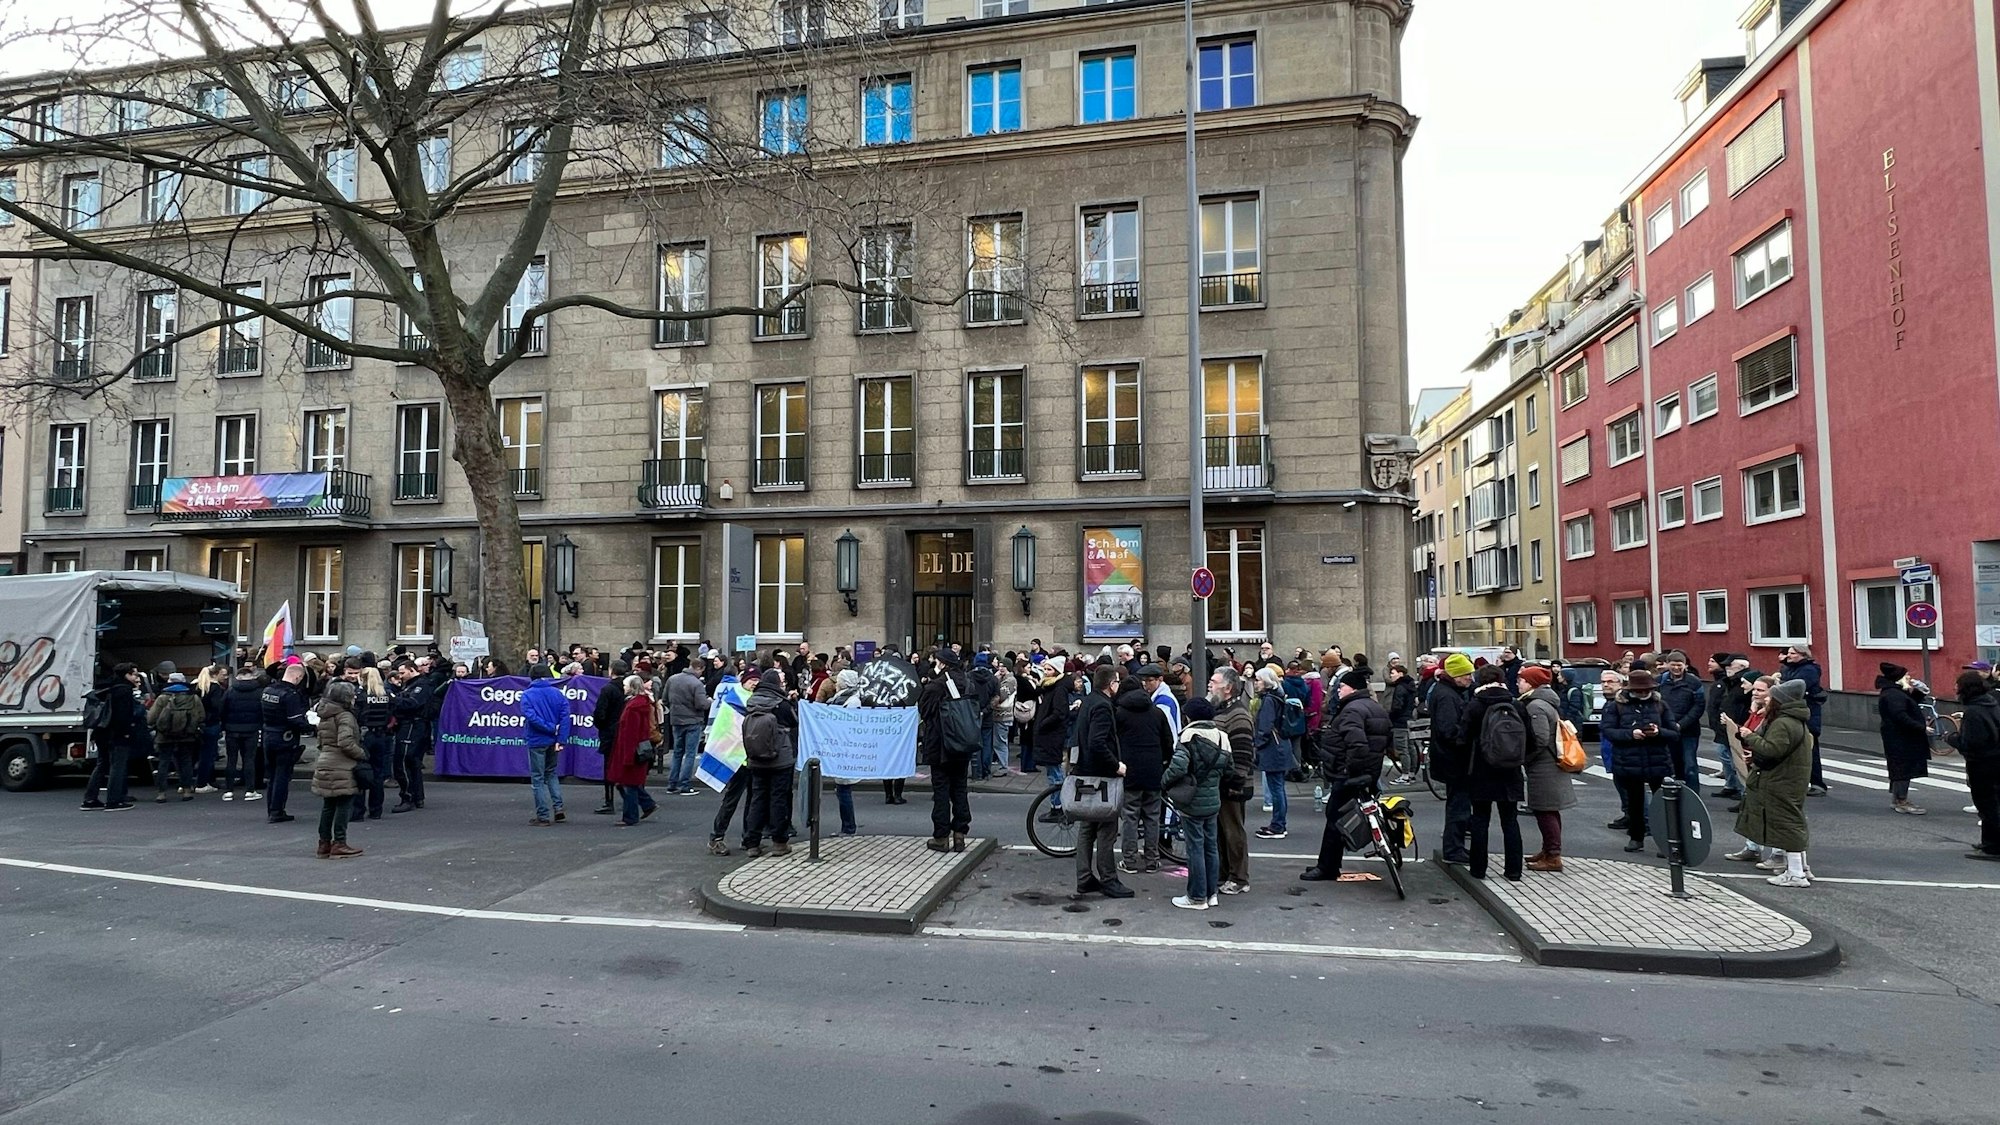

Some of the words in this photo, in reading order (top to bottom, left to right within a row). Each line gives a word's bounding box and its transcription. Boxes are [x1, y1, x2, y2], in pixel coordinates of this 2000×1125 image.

[1882, 147, 1906, 351] ELISENHOF
[1088, 537, 1139, 549] Schalom
[918, 552, 943, 574] EL
[863, 660, 917, 700] NAZIS
[480, 686, 524, 705] Gege
